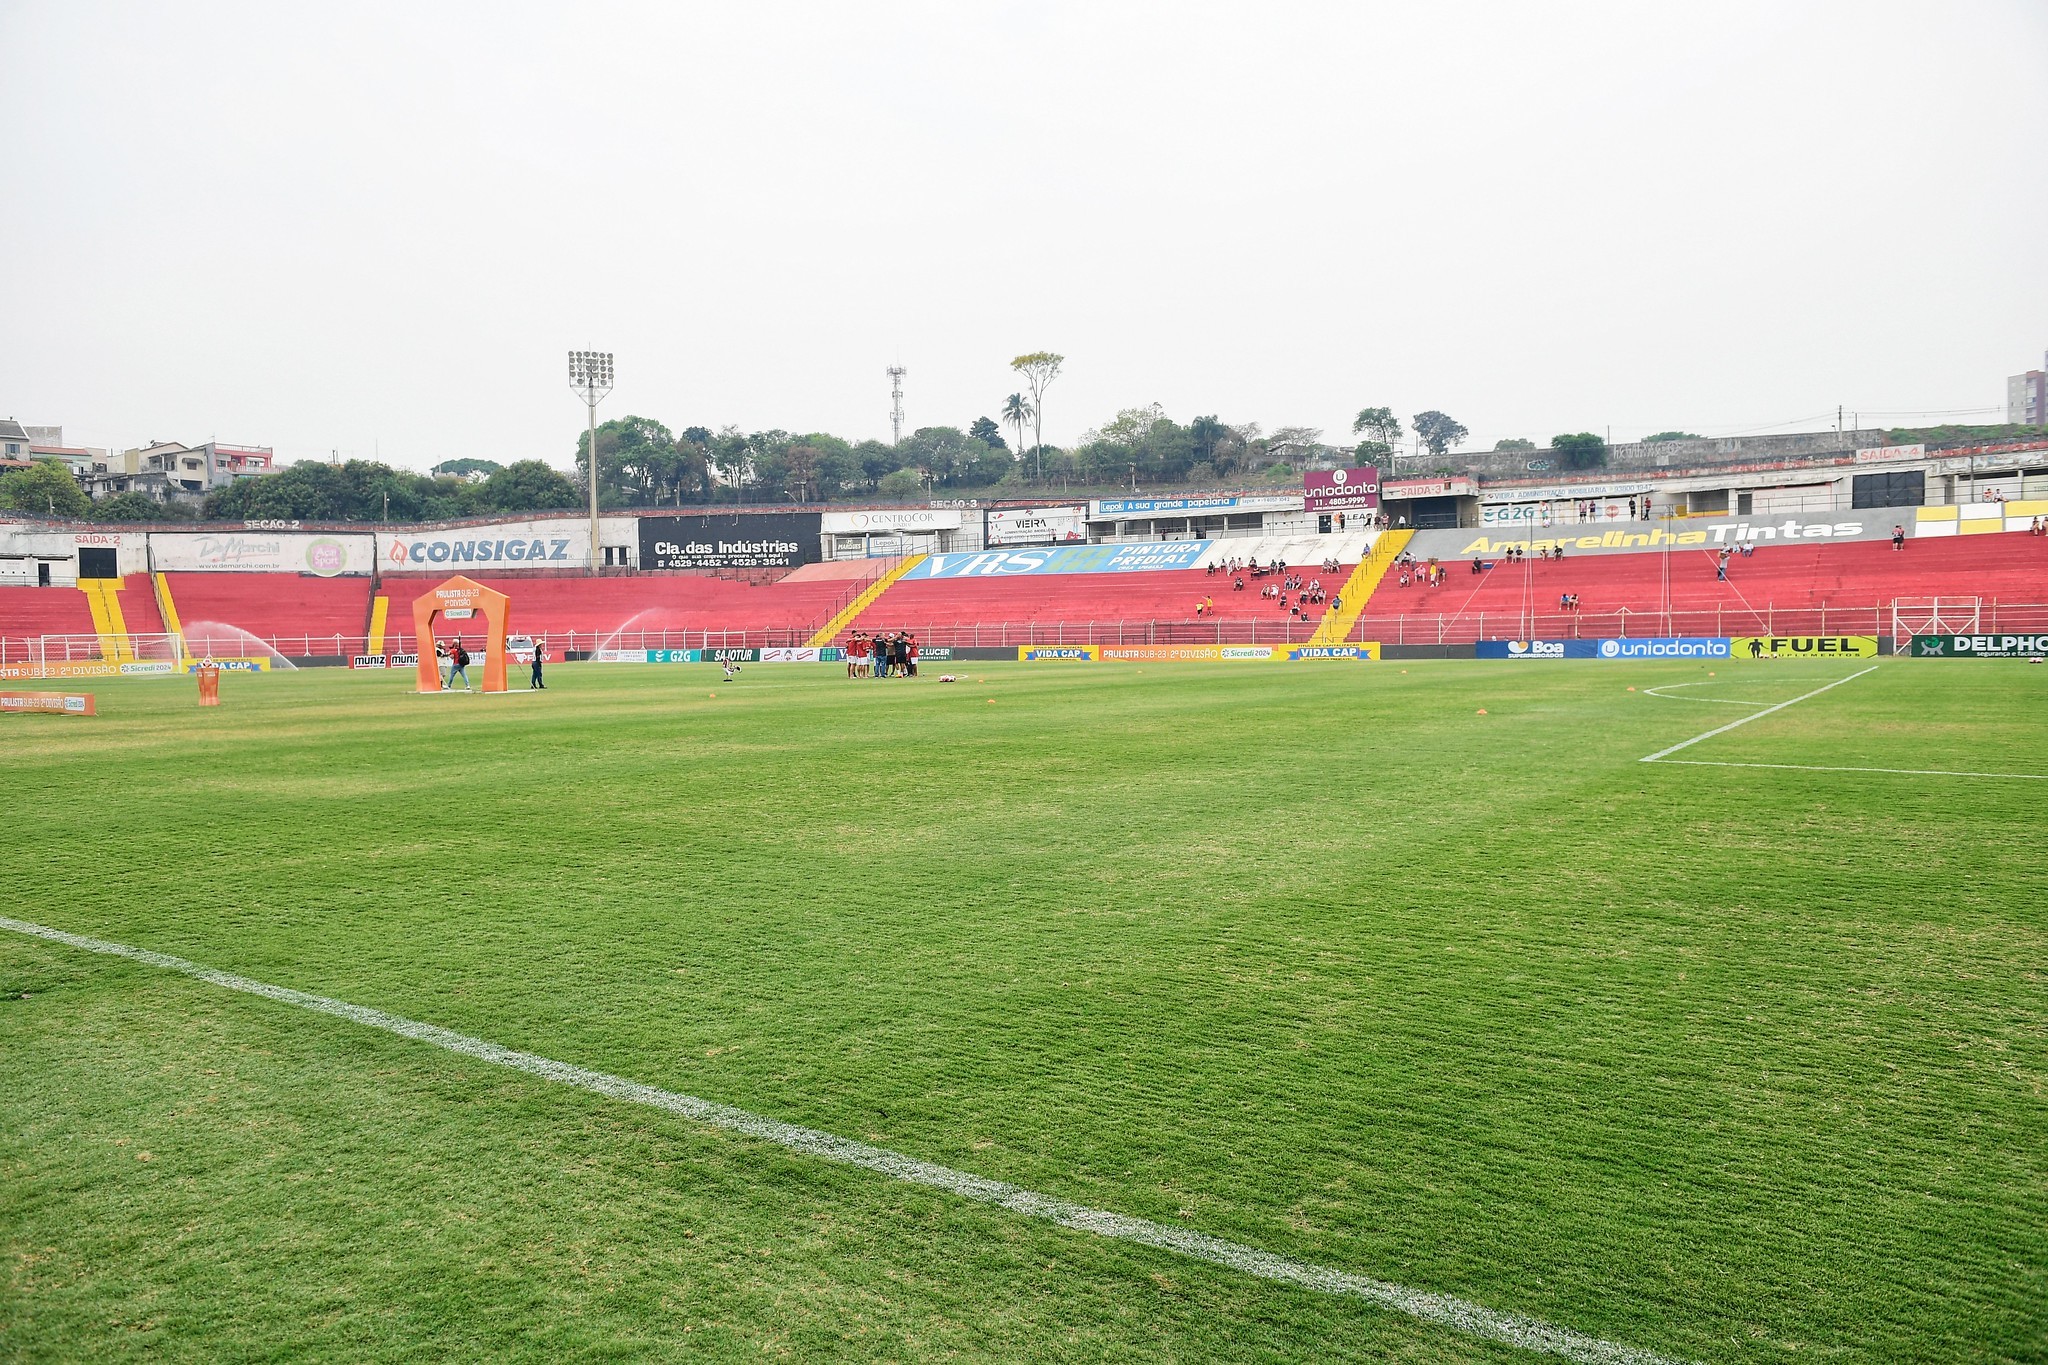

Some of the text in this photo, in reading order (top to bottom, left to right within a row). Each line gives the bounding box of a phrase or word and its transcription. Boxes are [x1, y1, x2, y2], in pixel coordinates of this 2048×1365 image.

[1304, 482, 1377, 497] uniodonto
[1128, 502, 1134, 510] A
[1154, 499, 1183, 510] grande
[1188, 498, 1229, 508] papelaria
[1329, 496, 1366, 506] 4805-9999
[1015, 519, 1047, 528] VIEIRA
[1460, 520, 1863, 555] Amarelinha Tintas
[409, 539, 571, 563] CONSIGAZ
[718, 539, 799, 554] Indústrias
[1118, 543, 1202, 556] PINTURA
[929, 550, 1056, 577] VRS
[1107, 554, 1188, 566] PREDIAL
[436, 590, 460, 598] PAULISTA
[449, 598, 470, 607] DIVISÃO
[1532, 641, 1564, 653] Boa
[1622, 640, 1727, 655] uniodonto
[1770, 638, 1859, 652] FUEL
[670, 650, 691, 662] G2G
[925, 648, 950, 656] LUCER
[1036, 650, 1081, 658] VIDA CAP
[1103, 650, 1139, 658] PAULISTA
[1140, 650, 1167, 658] SUB-23
[1180, 647, 1218, 659] DIVISÃO
[1300, 648, 1357, 657] VIDA CAP
[229, 661, 251, 670] CAP
[354, 656, 386, 665] muniz
[72, 664, 117, 675] DIVISÃO
[130, 664, 155, 672] Sicredi
[1, 697, 23, 707] PAULISTA
